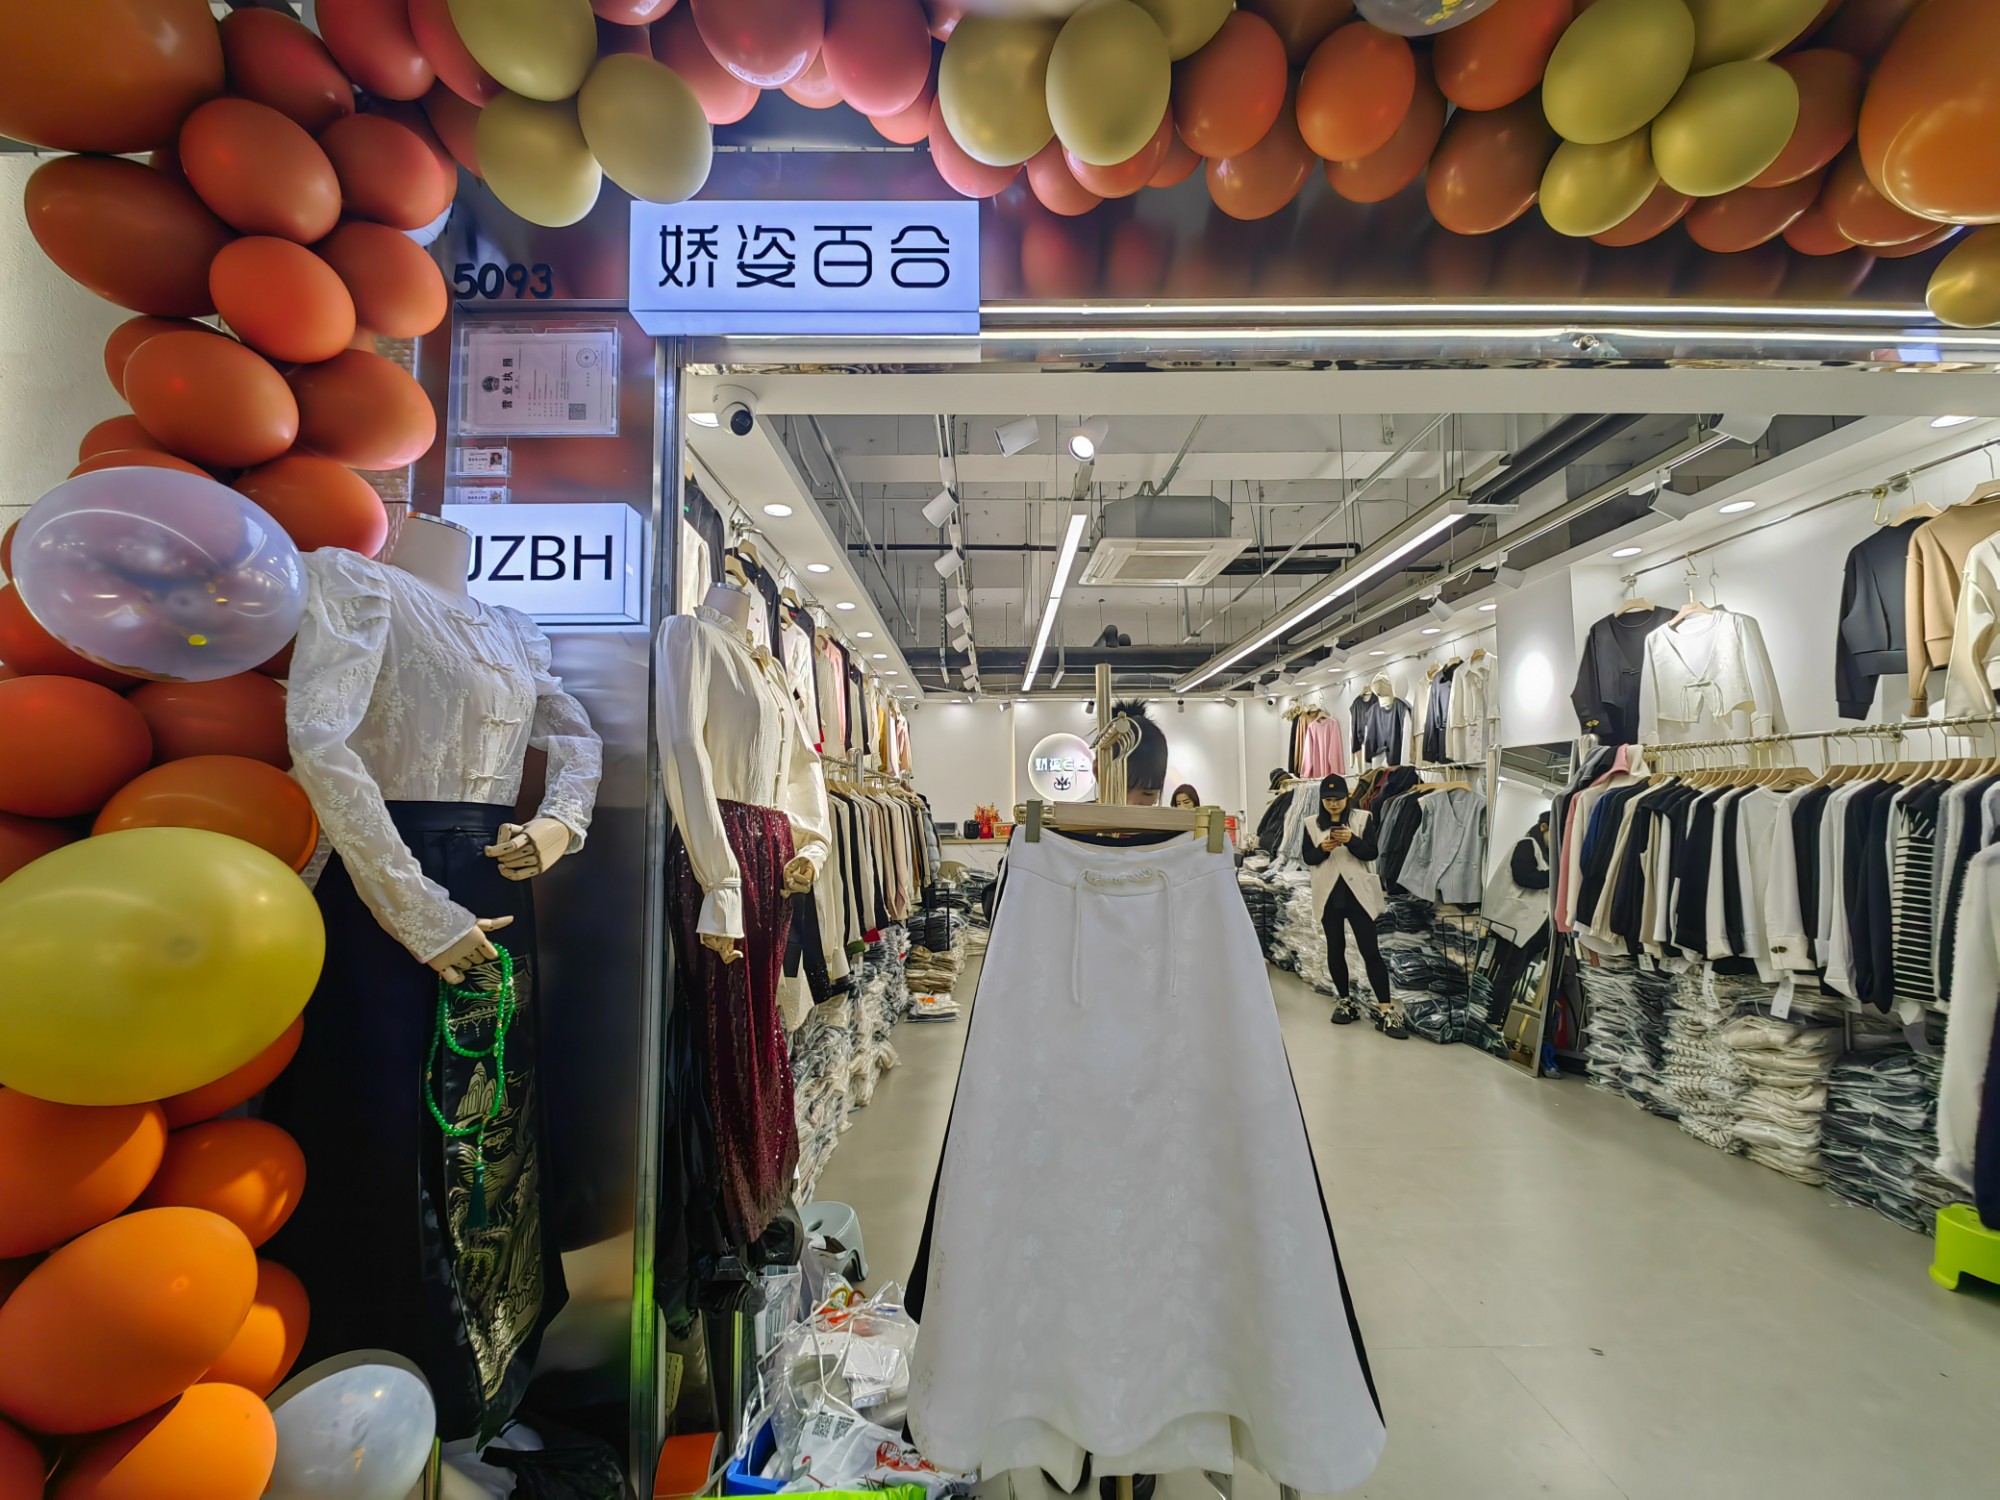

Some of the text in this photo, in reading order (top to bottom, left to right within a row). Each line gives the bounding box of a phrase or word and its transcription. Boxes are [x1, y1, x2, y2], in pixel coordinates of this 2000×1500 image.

[659, 225, 950, 288] 娇姿百合
[453, 262, 553, 300] 5093
[467, 535, 613, 582] JZBH
